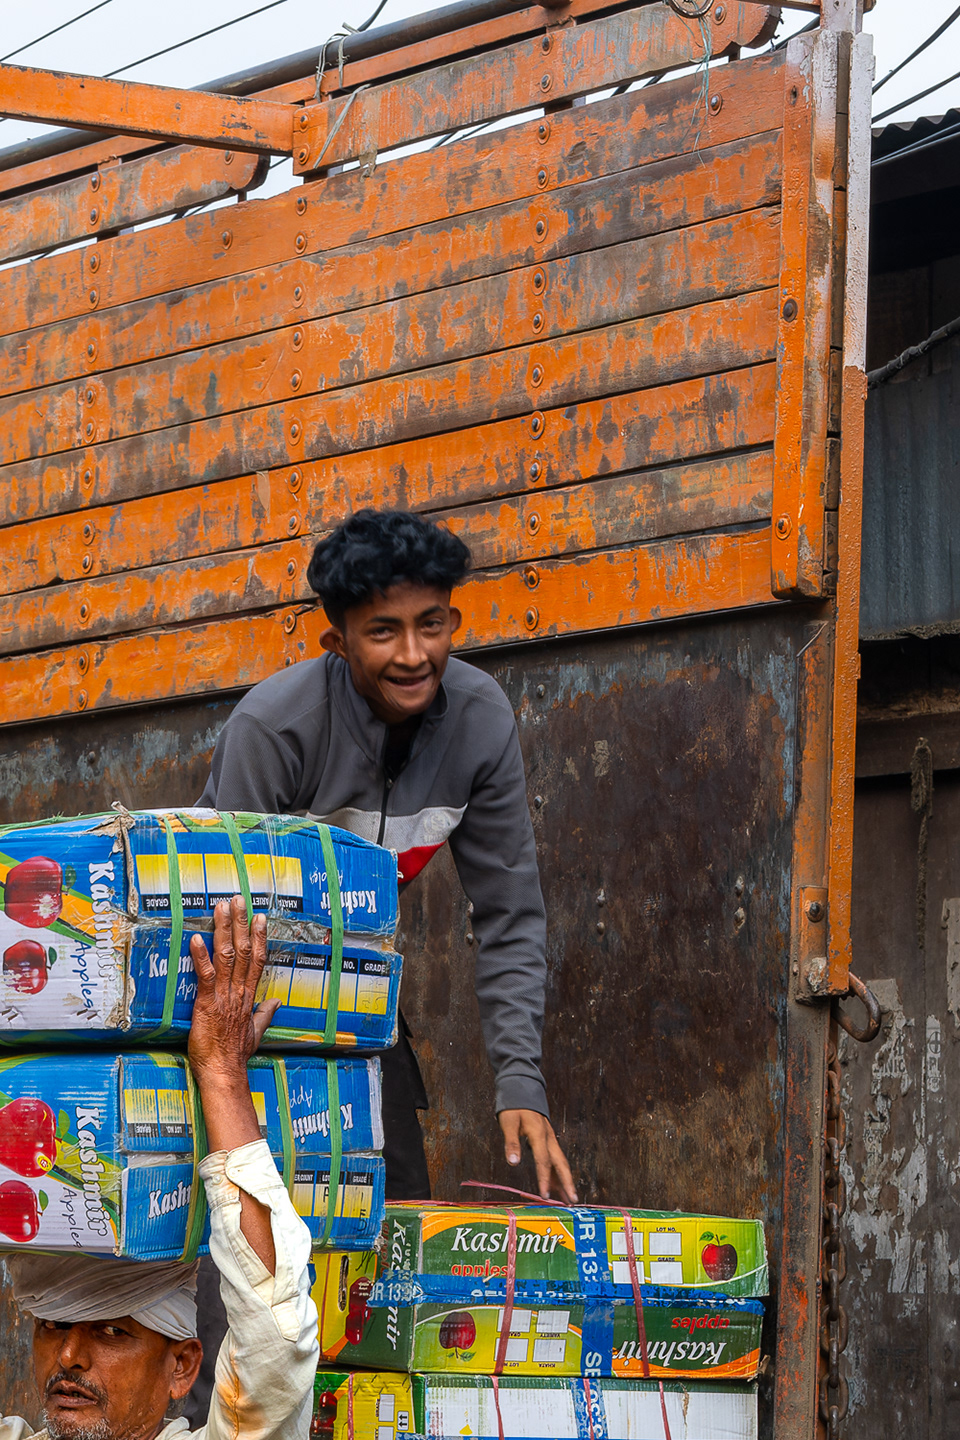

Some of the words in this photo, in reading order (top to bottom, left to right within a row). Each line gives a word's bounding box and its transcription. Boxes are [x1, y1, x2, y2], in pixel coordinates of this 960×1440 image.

[145, 897, 170, 908] GRADE
[88, 860, 118, 982] Kashmir
[72, 939, 94, 1009] Apples
[343, 960, 356, 969] NO.
[364, 963, 386, 973] GRADE
[76, 1106, 108, 1237] Kashmir
[148, 1180, 192, 1219] Kash
[451, 1259, 509, 1277] apples
[671, 1314, 730, 1334] apples
[611, 1340, 728, 1367] Kashmir
